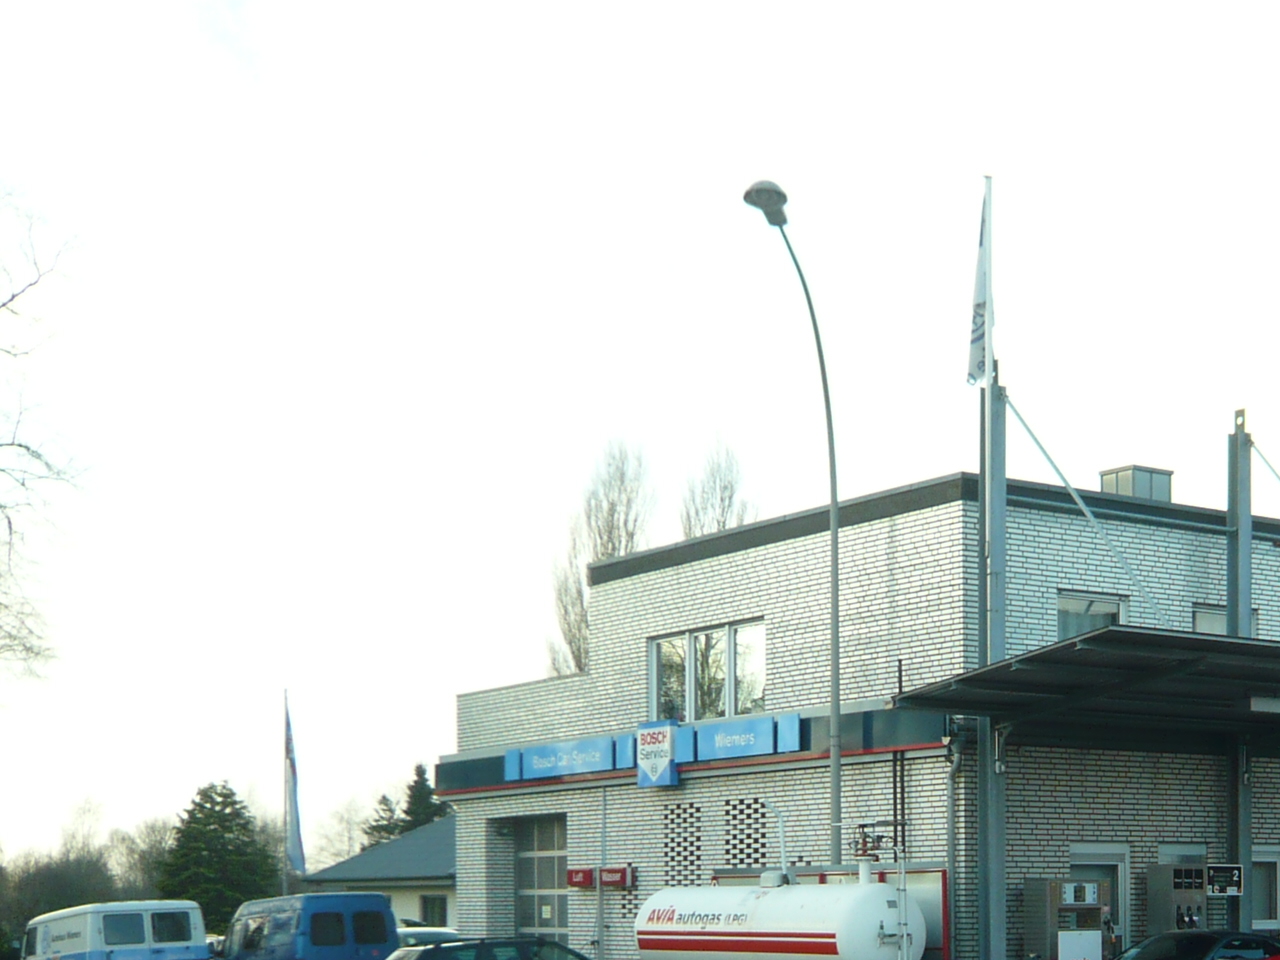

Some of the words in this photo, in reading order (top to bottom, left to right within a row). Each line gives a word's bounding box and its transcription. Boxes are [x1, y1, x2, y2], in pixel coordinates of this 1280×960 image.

[640, 730, 668, 746] BOSCH
[714, 732, 755, 748] Wiemers
[640, 746, 669, 761] Service
[1232, 870, 1240, 880] 2
[675, 911, 722, 930] autogas
